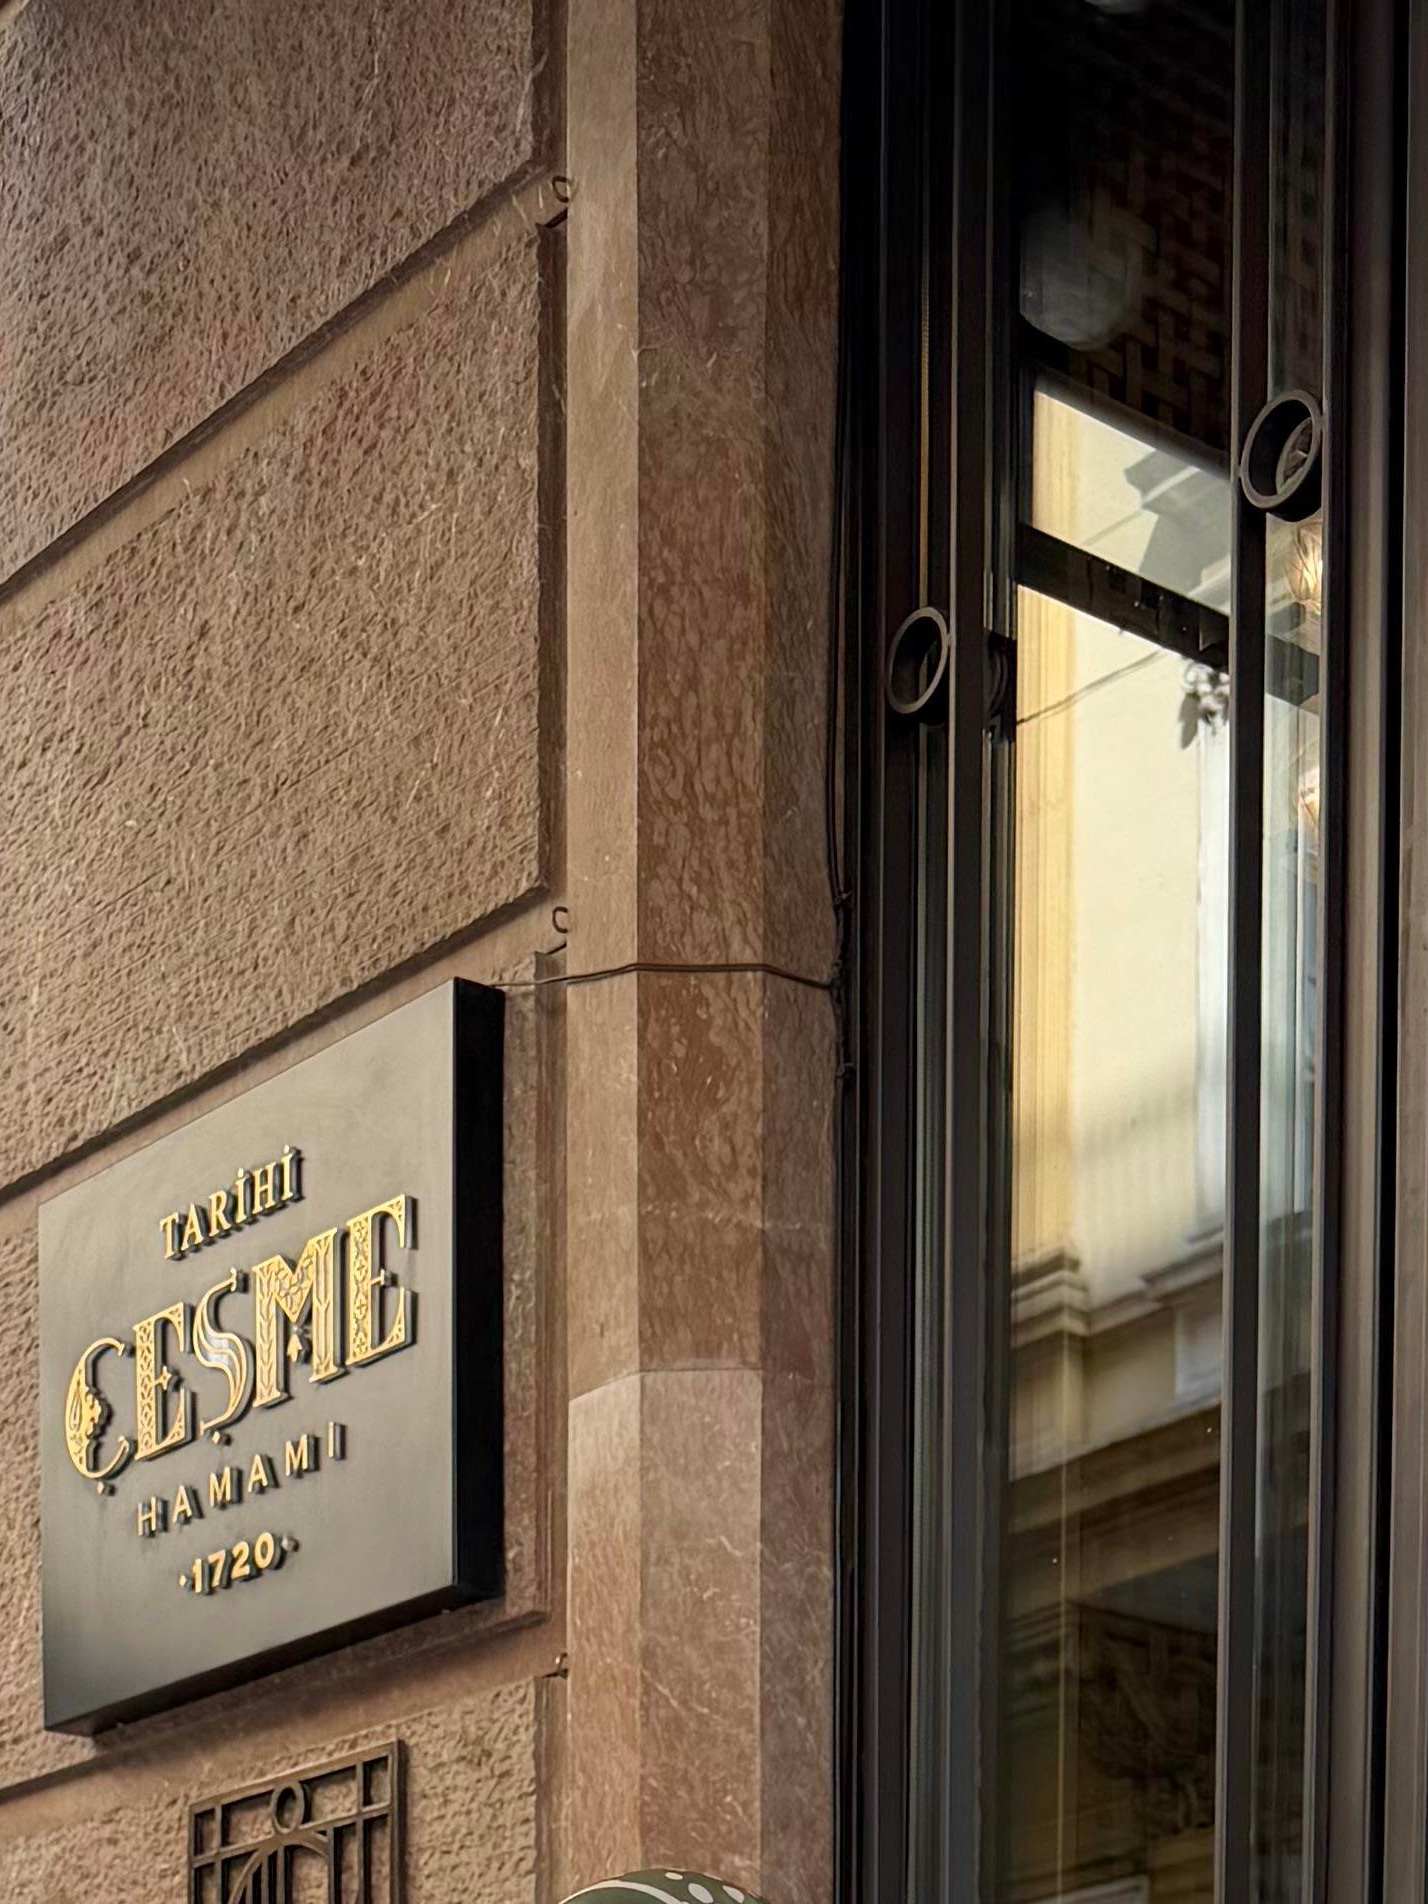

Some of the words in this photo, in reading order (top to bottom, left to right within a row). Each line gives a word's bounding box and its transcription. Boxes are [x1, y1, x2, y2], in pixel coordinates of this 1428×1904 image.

[159, 1144, 303, 1260] TARİHİ
[65, 1193, 418, 1494] ÇEŞME
[136, 1420, 346, 1538] HAMAMI
